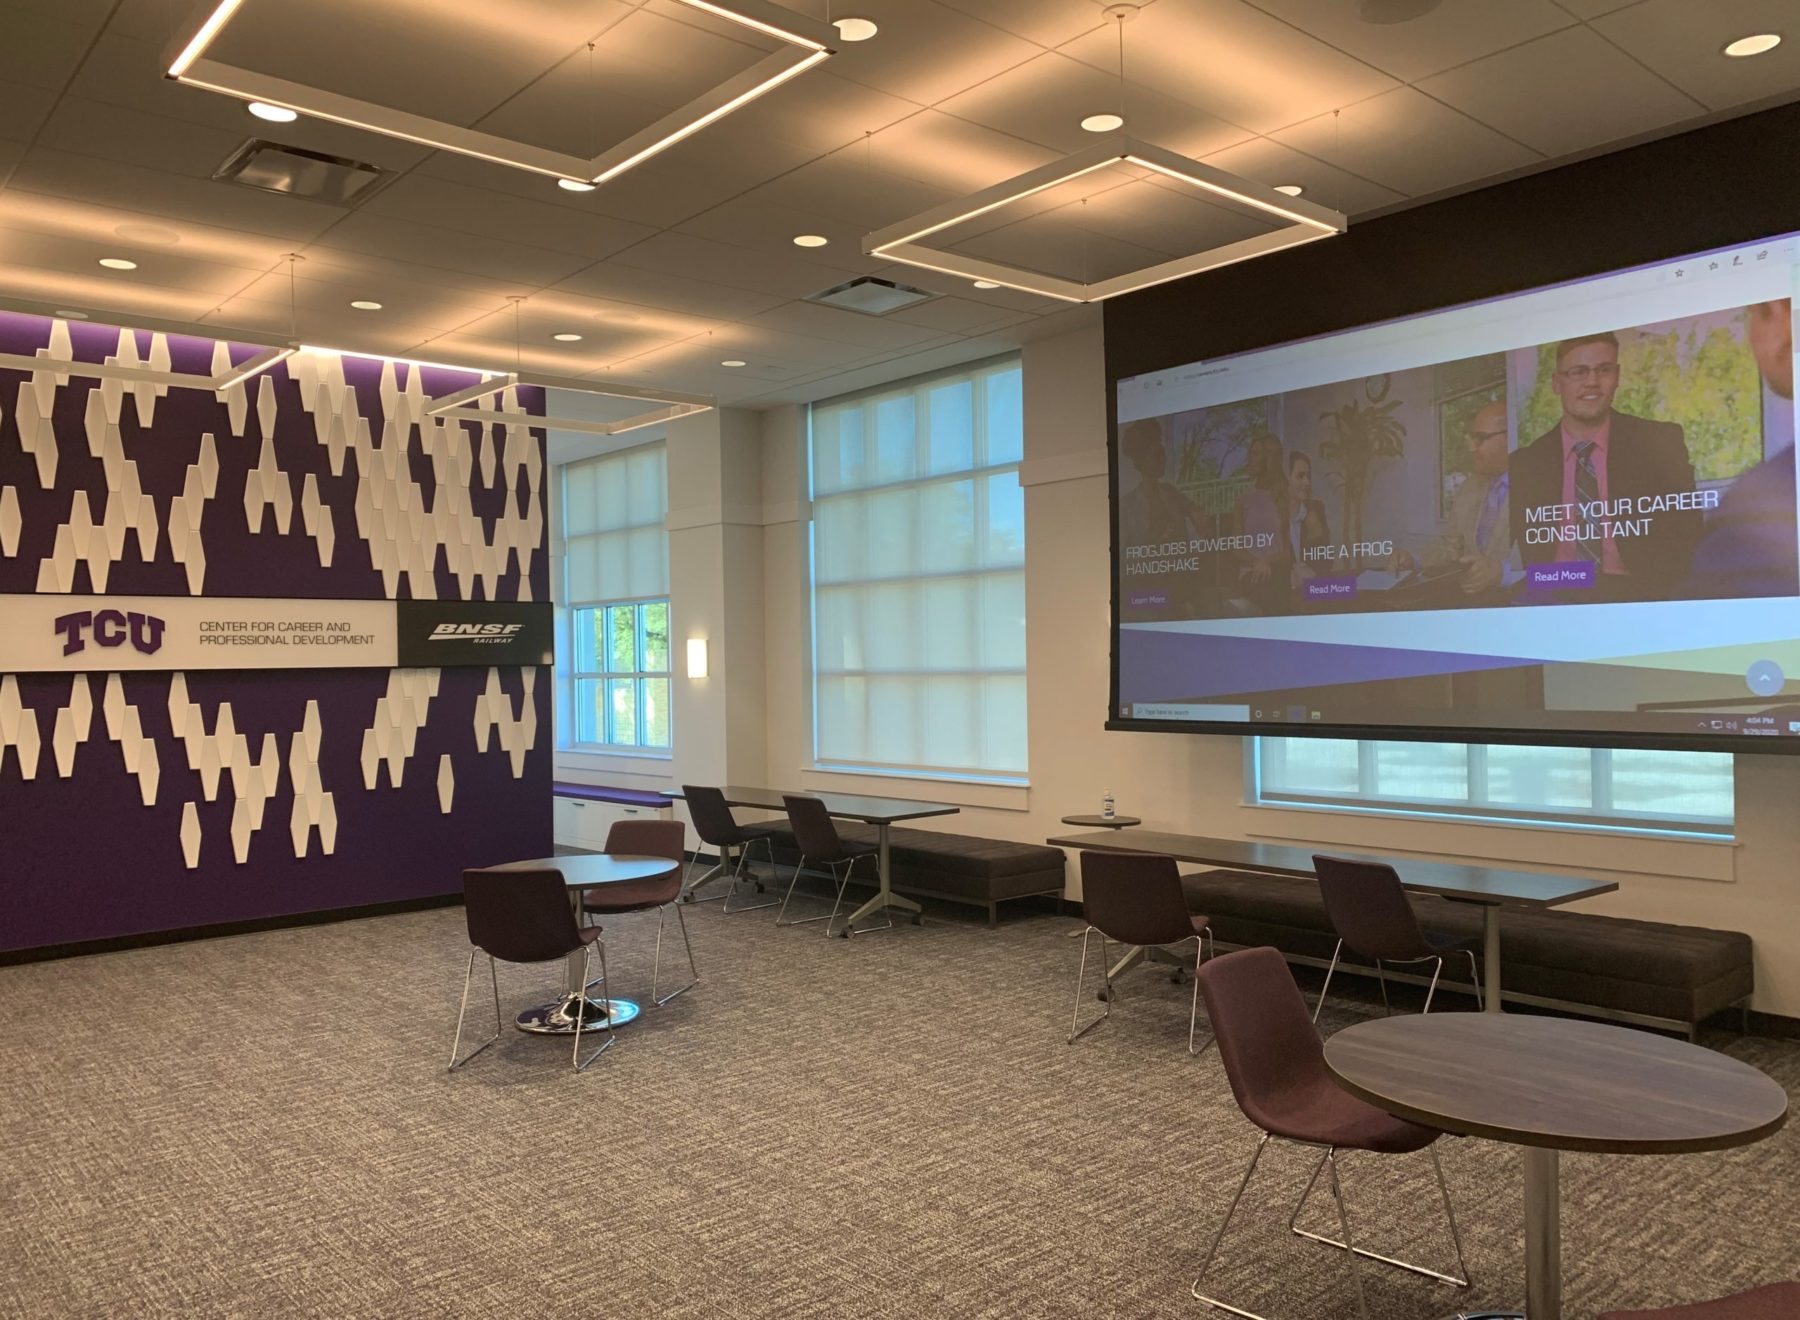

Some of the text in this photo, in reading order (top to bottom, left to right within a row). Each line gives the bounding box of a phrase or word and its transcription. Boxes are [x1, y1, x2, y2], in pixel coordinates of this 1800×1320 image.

[1525, 490, 1720, 523] MEET YOUR CAREER
[1525, 518, 1654, 544] CONSULTANT
[1126, 533, 1275, 559] FROGJOBS POWERED BY
[1303, 540, 1393, 561] HIRE A FROG
[1126, 557, 1200, 575] HANDSHAKE
[1534, 570, 1587, 582] Read More
[1309, 583, 1351, 594] Read More
[54, 609, 166, 657] TCU
[200, 621, 351, 632] CENTER FOR CAREER AND
[432, 623, 523, 634] BNSF
[199, 634, 376, 645] PROFESSIONAL DEVELOPMENT
